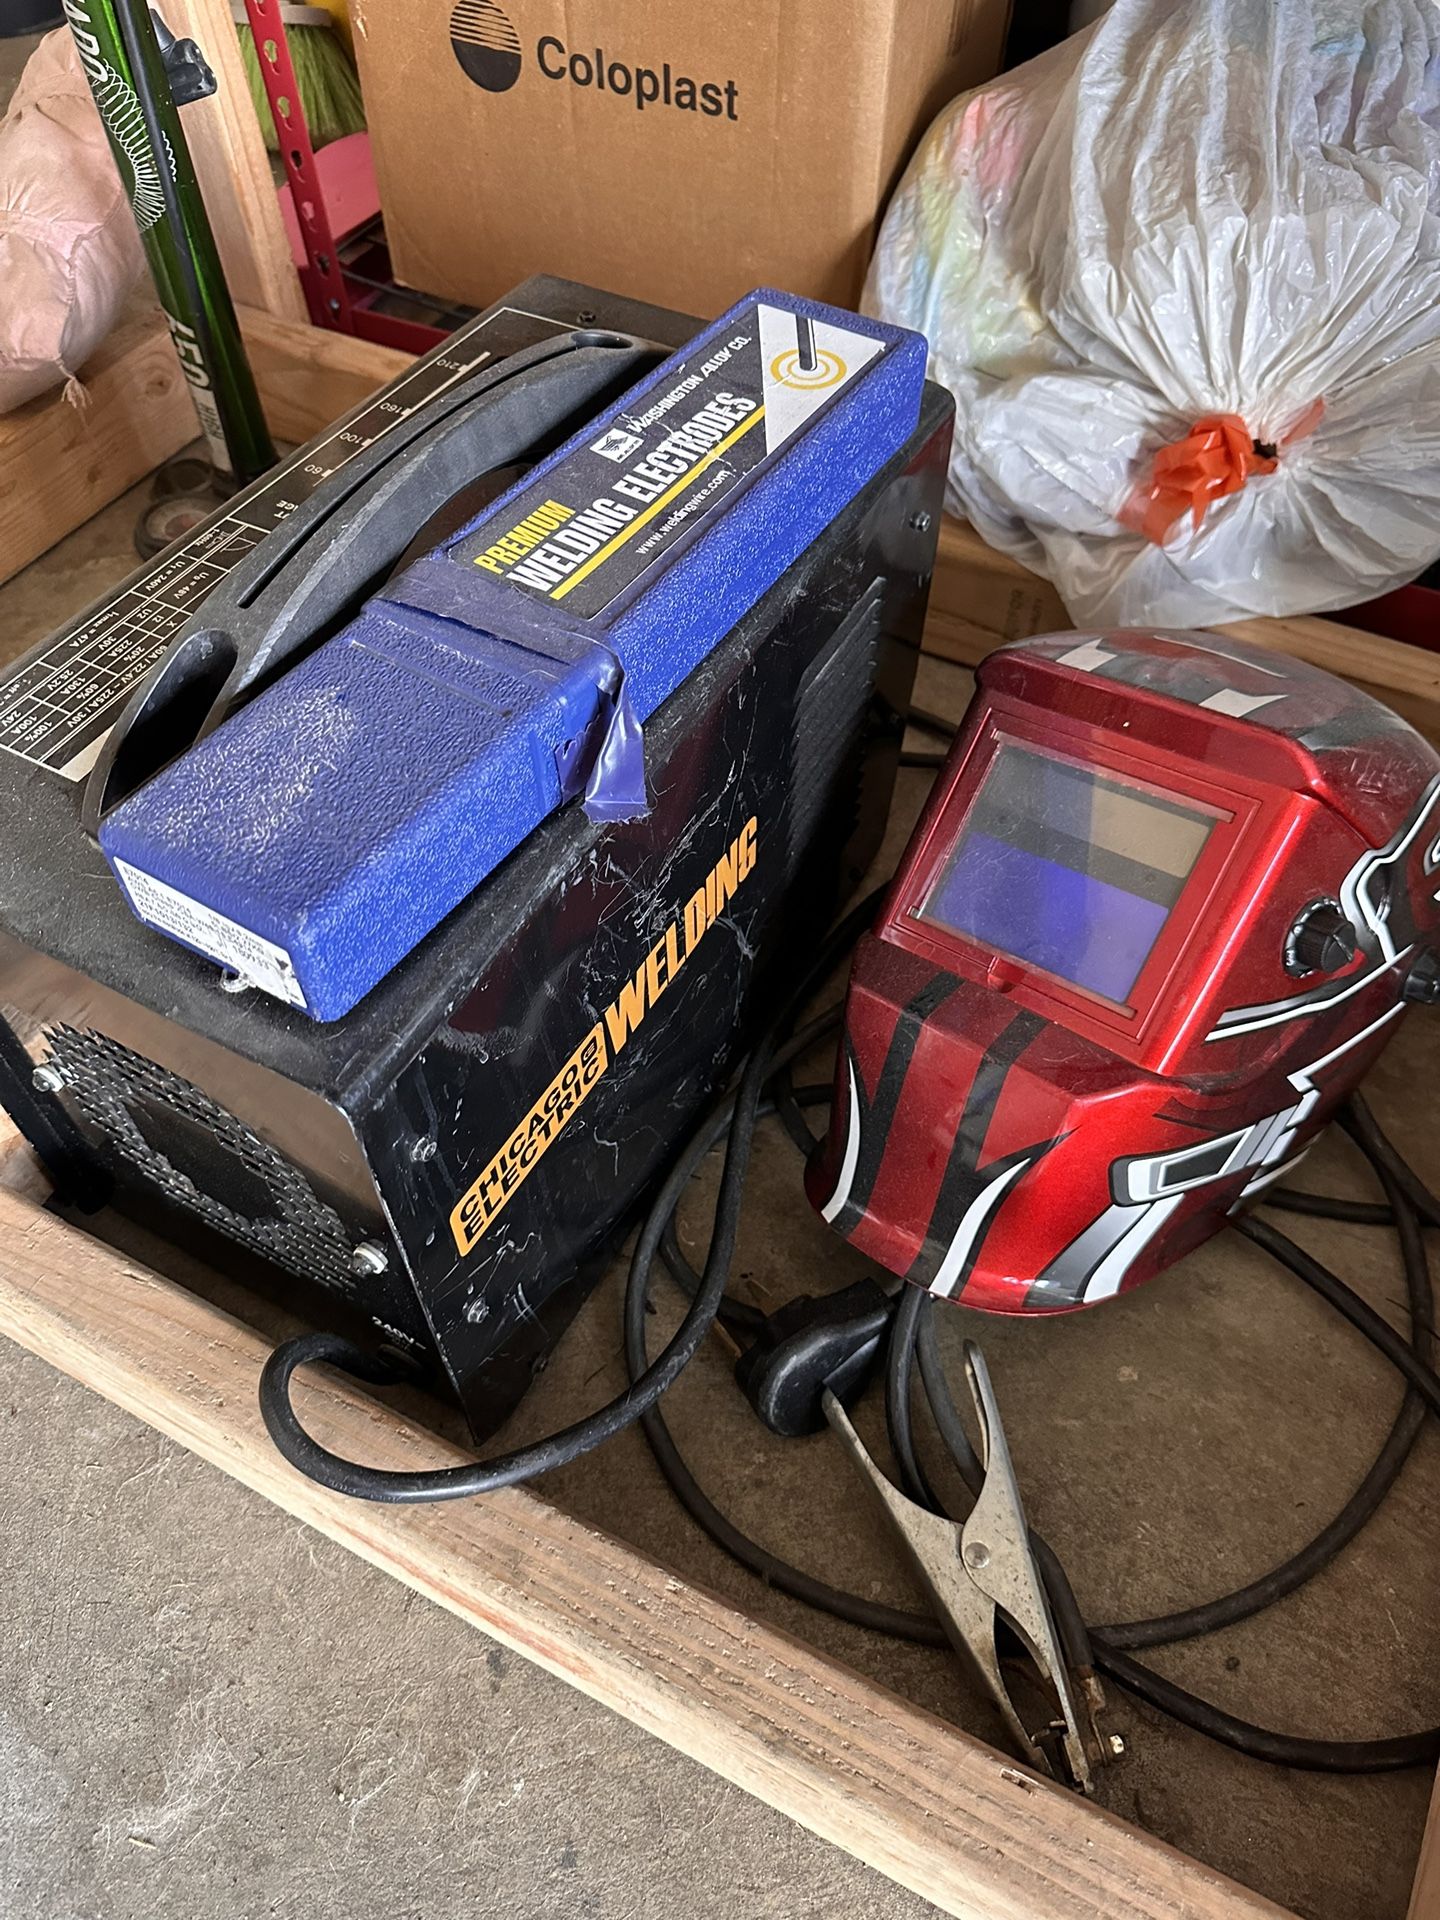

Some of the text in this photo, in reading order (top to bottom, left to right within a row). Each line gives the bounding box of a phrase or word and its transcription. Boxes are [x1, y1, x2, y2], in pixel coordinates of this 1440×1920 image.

[537, 35, 738, 121] Coloplast
[437, 359, 460, 370] 210
[626, 335, 752, 433] WASHINGTON ALLOY CO.
[380, 402, 402, 414] 160
[339, 432, 362, 444] 100
[612, 392, 757, 503] ELECTRODES
[304, 464, 323, 475] 60
[635, 470, 730, 555] www.weldingwire.com
[473, 499, 576, 574] PREMIUM
[505, 498, 639, 592] WELDING
[145, 574, 168, 592] 240V
[173, 585, 190, 599] 48V
[136, 608, 153, 620] U2
[69, 633, 89, 648] 47A
[98, 636, 117, 651] 30V
[108, 639, 133, 658] 225A
[123, 646, 146, 662] 20%
[46, 669, 74, 691] 25.2V
[121, 663, 147, 684] 22.4V
[60, 677, 86, 696] 130A
[76, 683, 100, 700] 60%
[89, 689, 115, 708] 225A
[1, 710, 21, 727] 24V
[10, 715, 38, 736] 100A
[67, 711, 87, 728] 30V
[24, 721, 53, 742] 100%
[605, 816, 758, 1055] WELDING
[460, 1064, 578, 1222] CHICAGO
[463, 1057, 600, 1244] ELECTRIC
